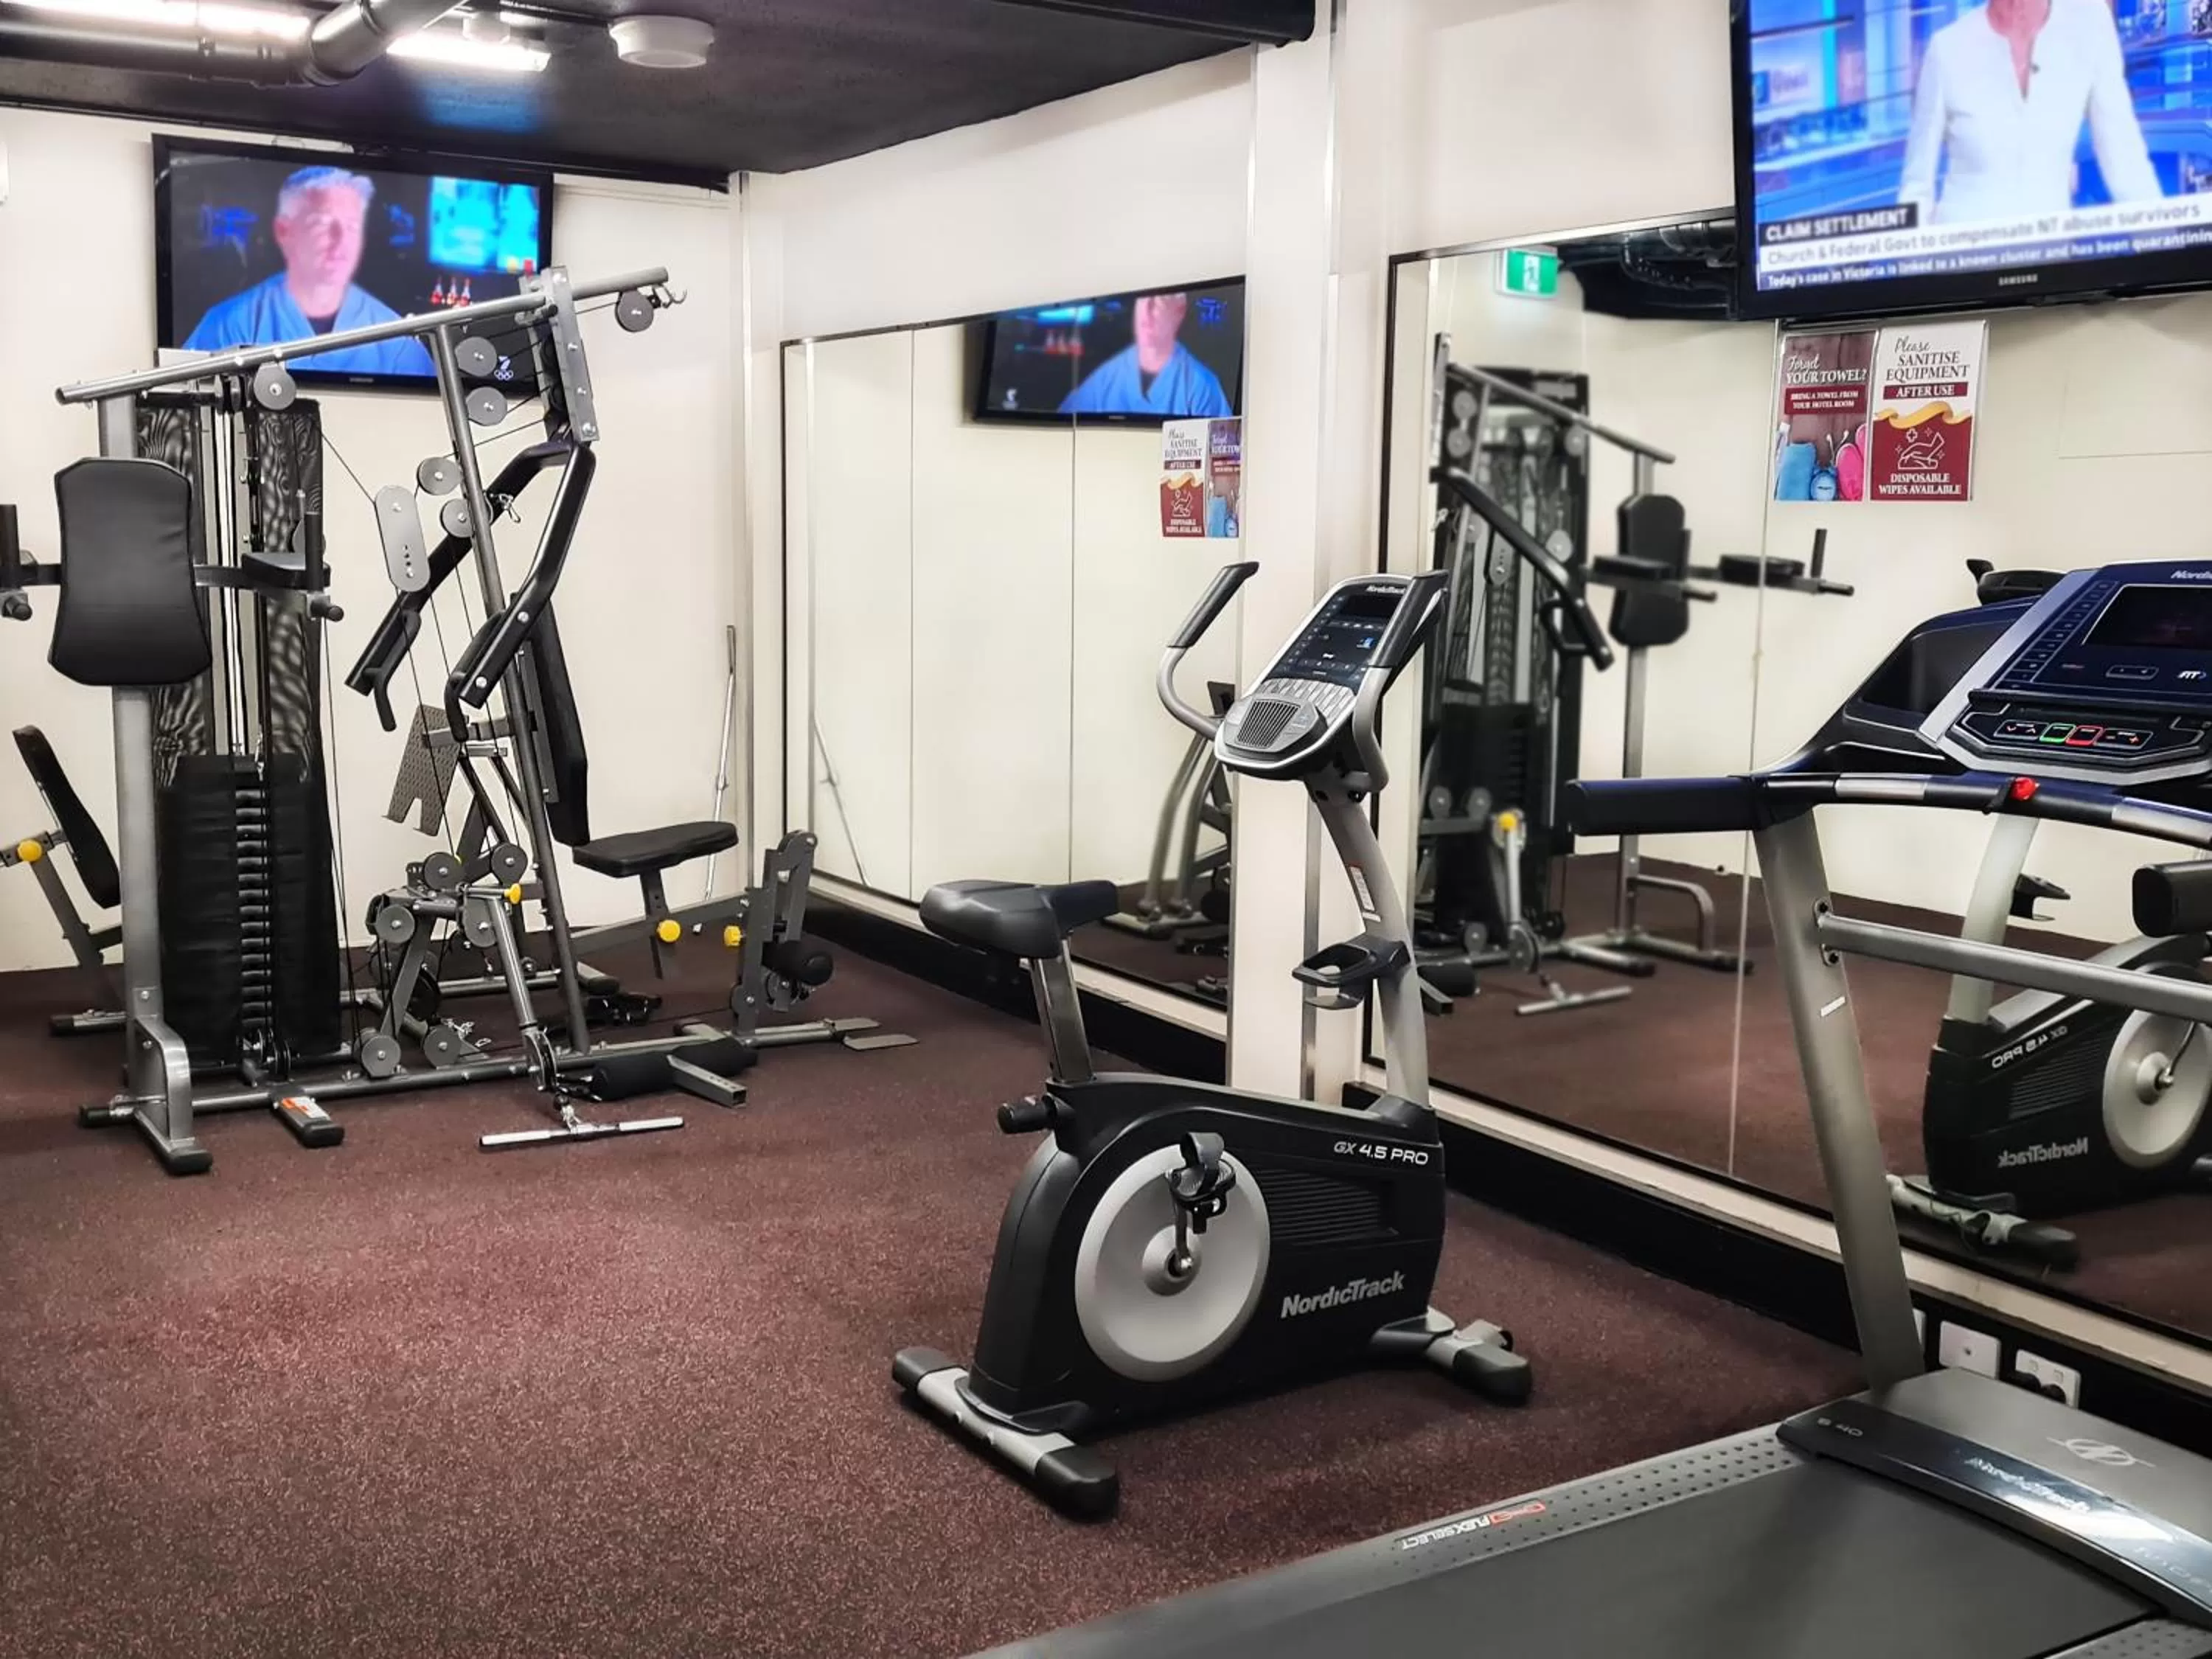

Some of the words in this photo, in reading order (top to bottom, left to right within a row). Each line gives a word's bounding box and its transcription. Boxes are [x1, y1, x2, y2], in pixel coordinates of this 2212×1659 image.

[1766, 220, 1811, 241] CLAIM
[1814, 208, 1908, 235] SETTLEMENT
[1769, 246, 1815, 264] Church
[1830, 240, 1879, 257] Federal
[1884, 234, 1916, 251] Govt
[1921, 232, 1935, 248] to
[1939, 223, 2033, 246] compensate
[2037, 216, 2058, 233] NT
[2063, 215, 2112, 232] abuse
[2118, 204, 2201, 224] survivors
[1844, 266, 1885, 281] Victoria
[2045, 244, 2070, 258] and
[2072, 241, 2093, 255] has
[2097, 238, 2131, 252] been
[1894, 335, 1931, 352] Please
[1897, 351, 1960, 366] SANITISE
[1787, 370, 1818, 383] YOUR
[1820, 369, 1867, 383] TOWEL?
[1886, 364, 1970, 383] EQUIPMENT
[1896, 385, 1932, 397] AFTER
[1933, 384, 1955, 396] USE
[1891, 473, 1950, 483] DISPOSABLE
[1878, 484, 1908, 495] WIPES
[1909, 484, 1962, 495] AVAILABLE
[1334, 1141, 1357, 1155] GX
[1359, 1144, 1388, 1160] 4.5
[1390, 1147, 1429, 1166] PRO
[1280, 1270, 1407, 1318] NordicTrack
[1402, 1514, 1490, 1551] FLEXSELECT
